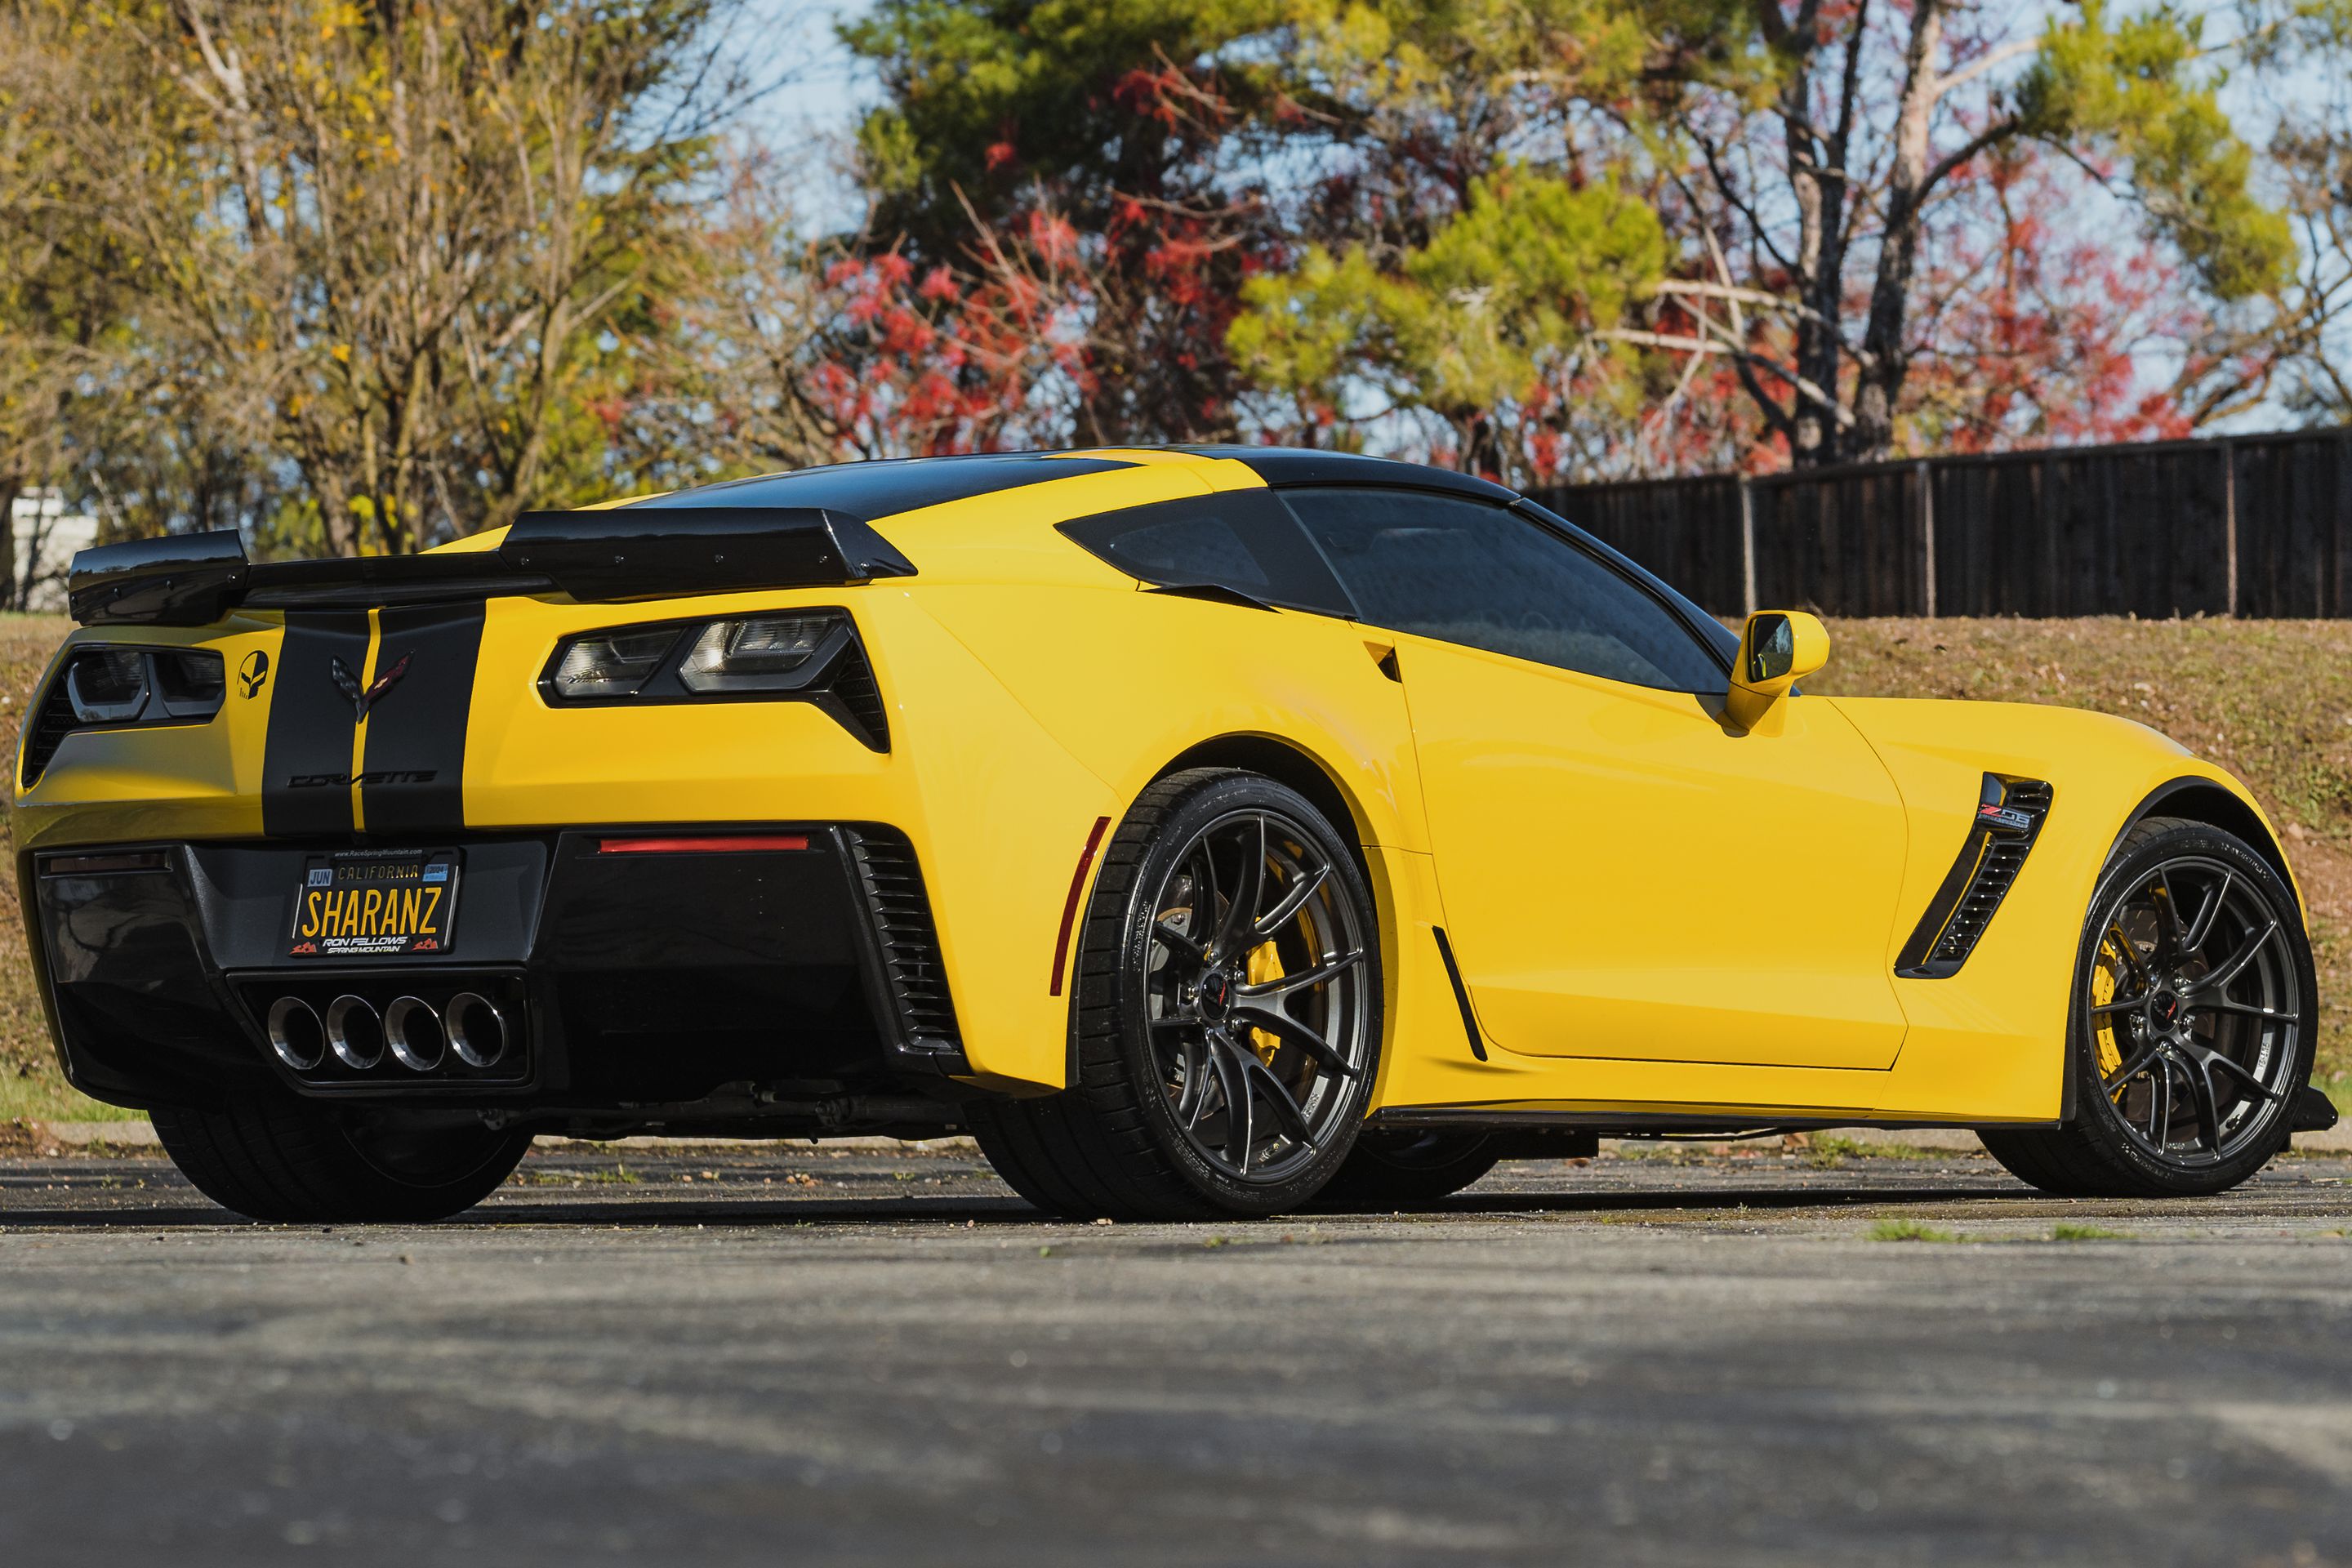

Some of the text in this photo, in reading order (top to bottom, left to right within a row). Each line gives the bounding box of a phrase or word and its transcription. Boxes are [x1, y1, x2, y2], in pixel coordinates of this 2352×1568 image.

[287, 770, 438, 787] CORVETTE
[310, 870, 330, 884] JUN
[338, 864, 418, 880] CALIFORNIA
[301, 887, 442, 937] SHARANZ
[322, 936, 408, 947] RON FELLOWS
[358, 945, 401, 954] MOUNTAIN
